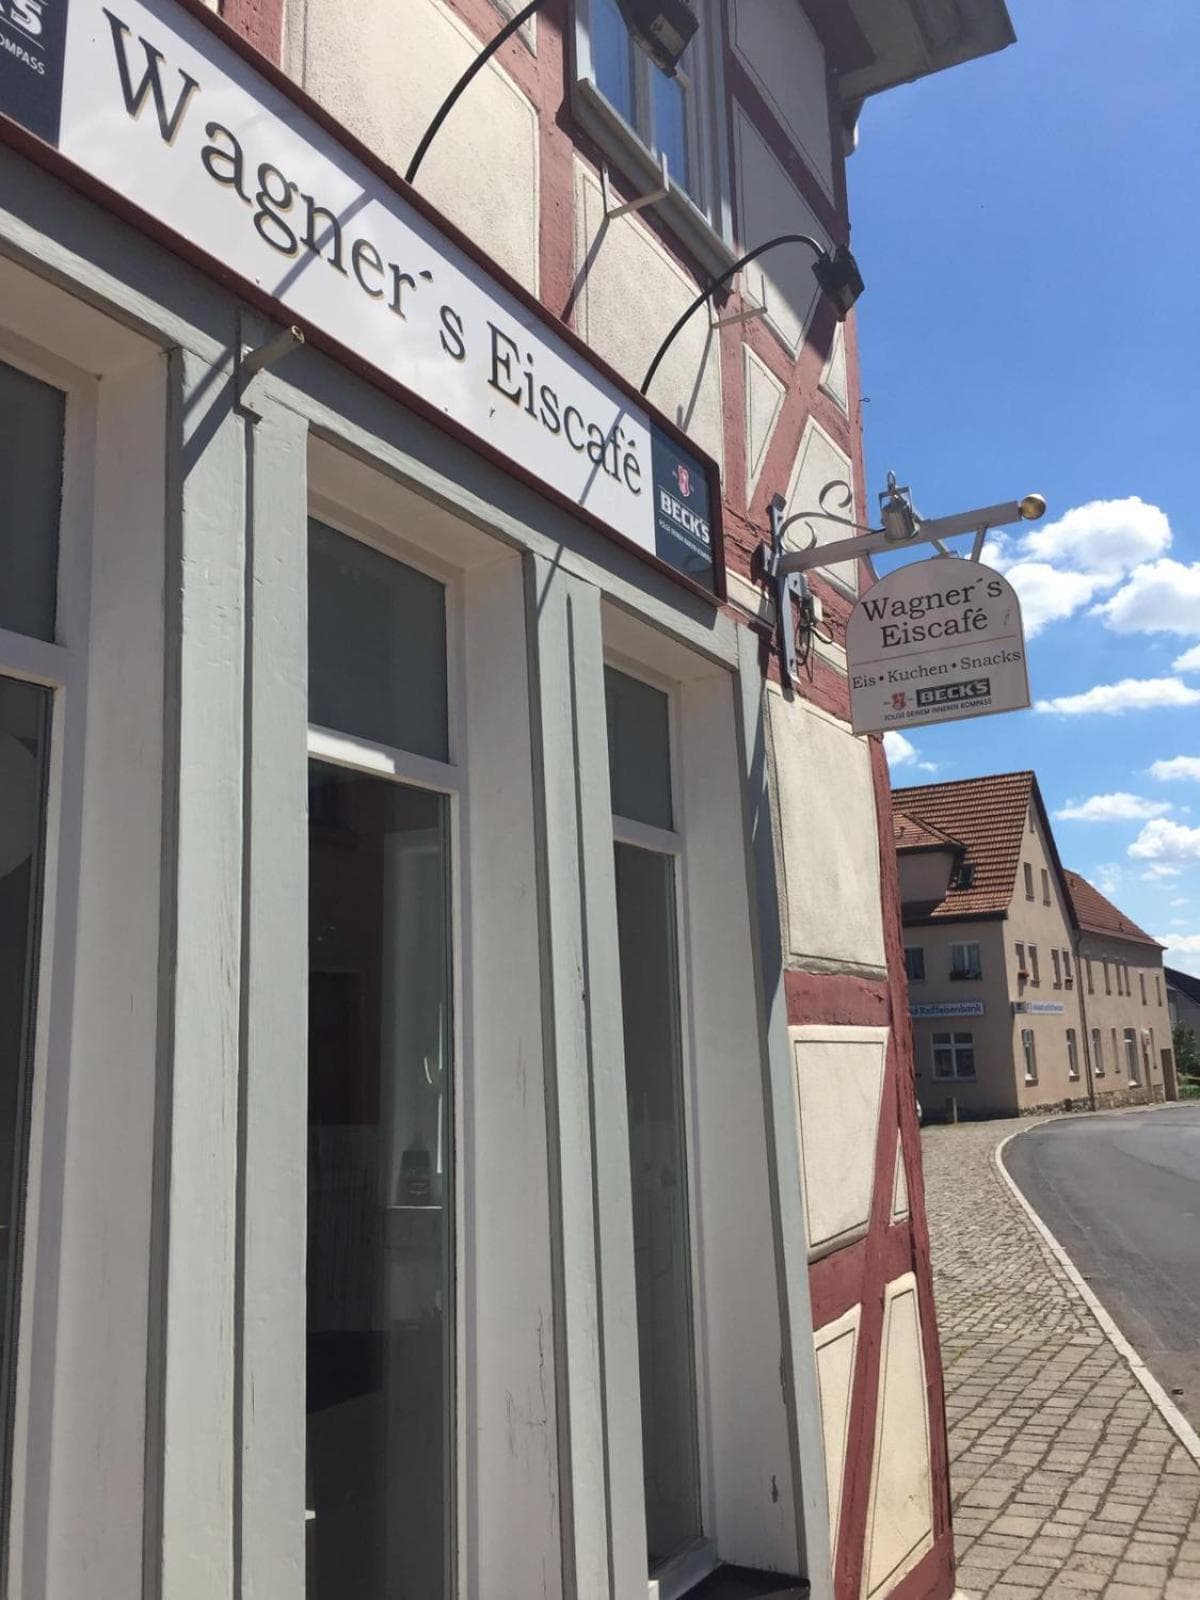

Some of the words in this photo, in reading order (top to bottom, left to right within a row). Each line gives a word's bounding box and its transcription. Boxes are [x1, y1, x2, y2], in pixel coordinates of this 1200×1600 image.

[486, 320, 642, 496] Eiscafé
[881, 607, 989, 649] Eiscafé
[852, 676, 877, 690] Eis
[887, 663, 949, 684] Kuchen
[960, 650, 1022, 671] Snacks
[960, 697, 992, 709] KOMPASS
